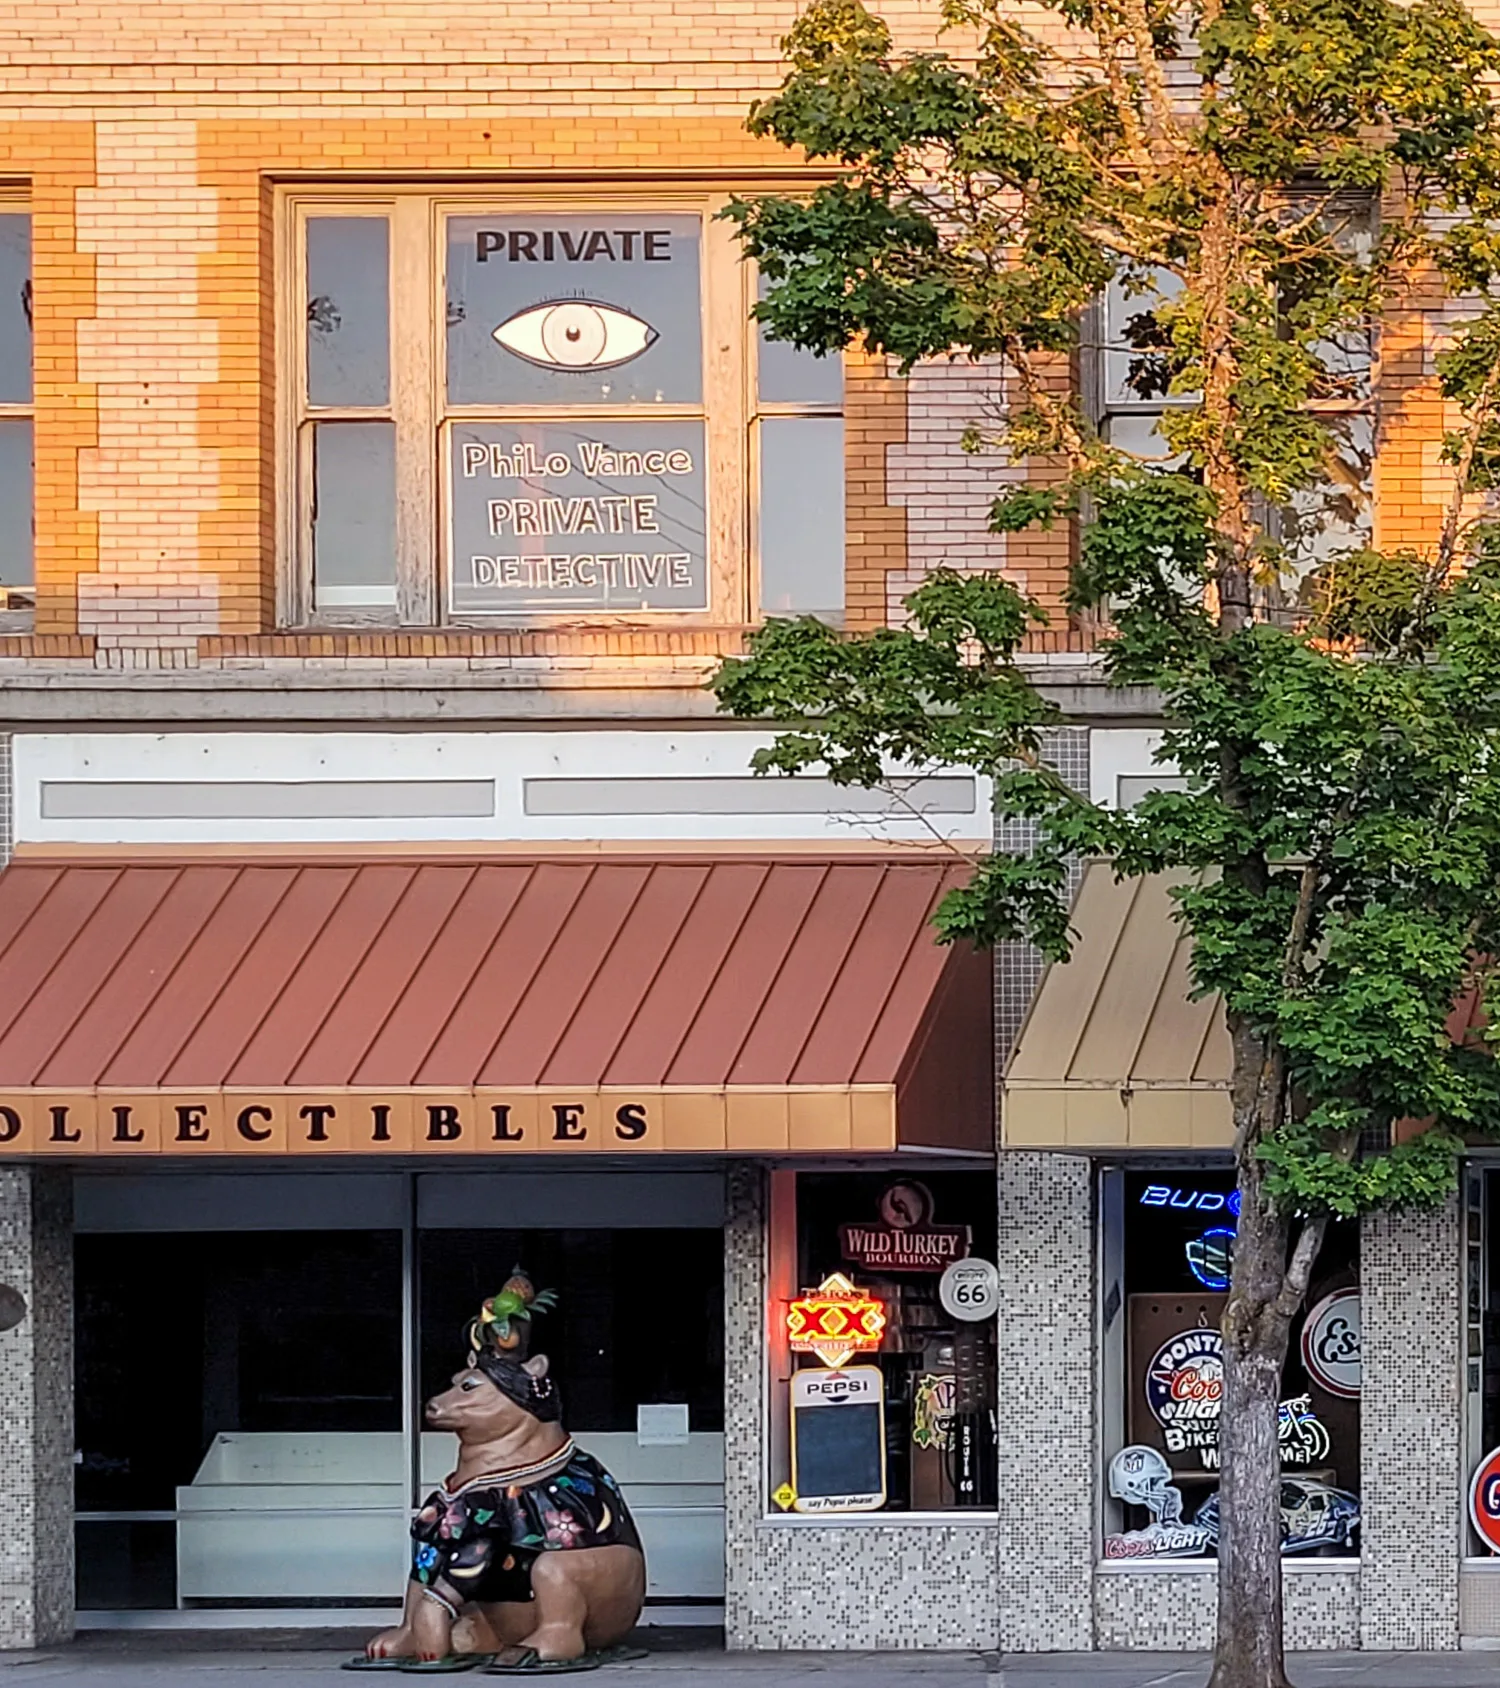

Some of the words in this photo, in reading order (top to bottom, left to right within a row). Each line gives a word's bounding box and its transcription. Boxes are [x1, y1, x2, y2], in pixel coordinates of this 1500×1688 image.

[476, 230, 671, 262] PRIVATE
[578, 443, 692, 477] Vance
[488, 494, 659, 537] PRIVATE
[471, 553, 692, 589] DETECTIVE
[1139, 1186, 1225, 1210] BUD
[847, 1229, 890, 1252] WILD
[890, 1229, 959, 1255] TURKEY
[866, 1253, 942, 1265] BOURBON
[957, 1285, 985, 1303] 66
[807, 1380, 868, 1394] PEPSI
[961, 1480, 973, 1491] 66
[1155, 1531, 1208, 1551] LIGHT
